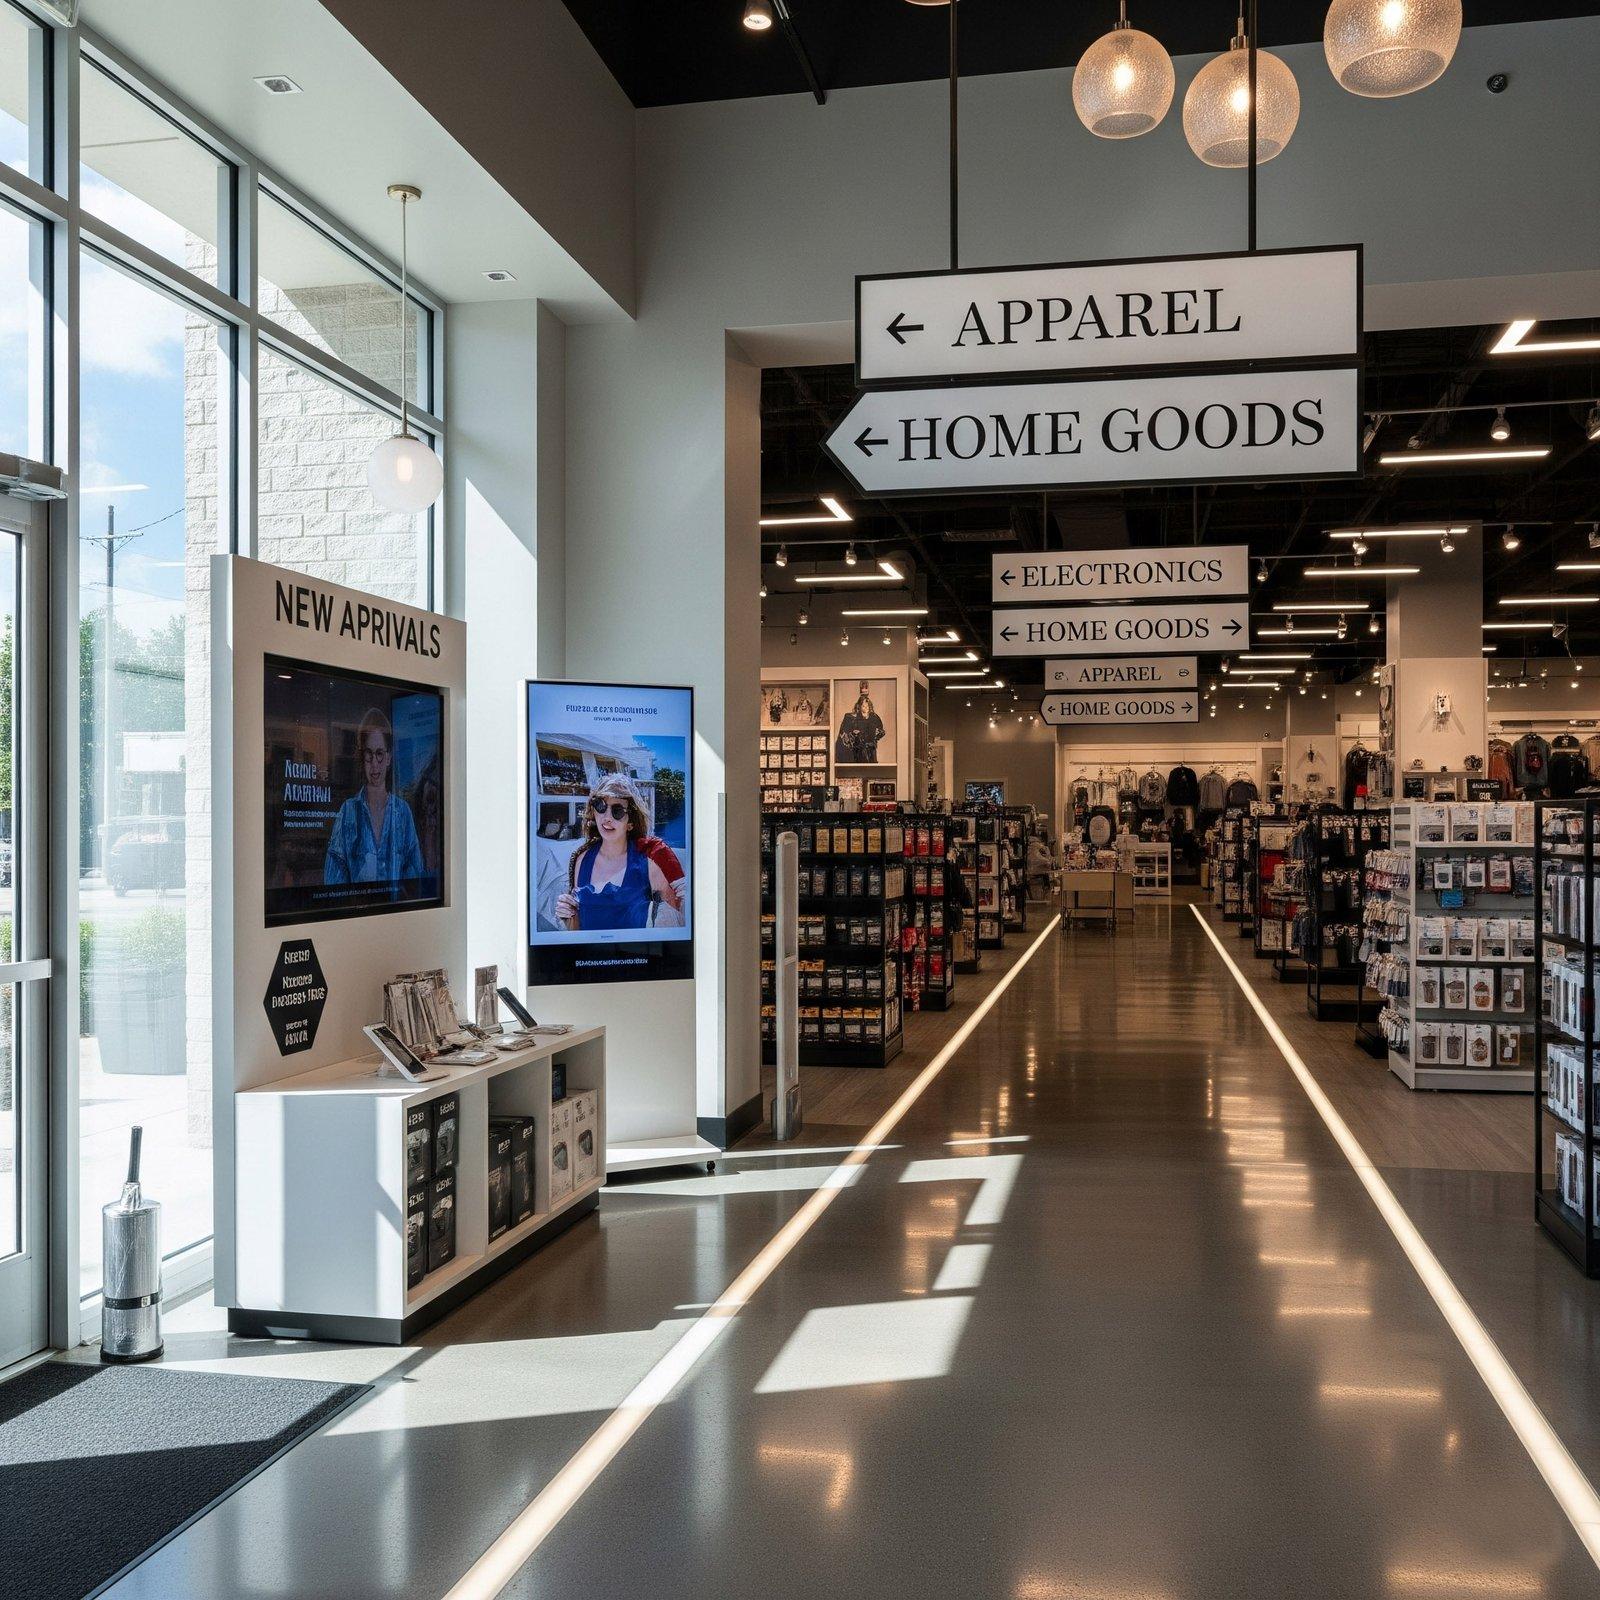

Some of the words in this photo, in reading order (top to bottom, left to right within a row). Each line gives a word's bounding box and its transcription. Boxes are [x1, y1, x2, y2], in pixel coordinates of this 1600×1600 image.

[951, 288, 1242, 347] APPAREL
[898, 411, 1082, 462] HOME
[1101, 398, 1325, 453] GOODS
[1021, 559, 1223, 588] ELECTRONICS
[276, 580, 334, 633] NEW
[1026, 620, 1108, 643] HOME
[1114, 617, 1210, 641] GOODS
[1078, 666, 1162, 683] APPAREL
[1060, 701, 1110, 716] HOME
[1114, 700, 1175, 716] GOODS
